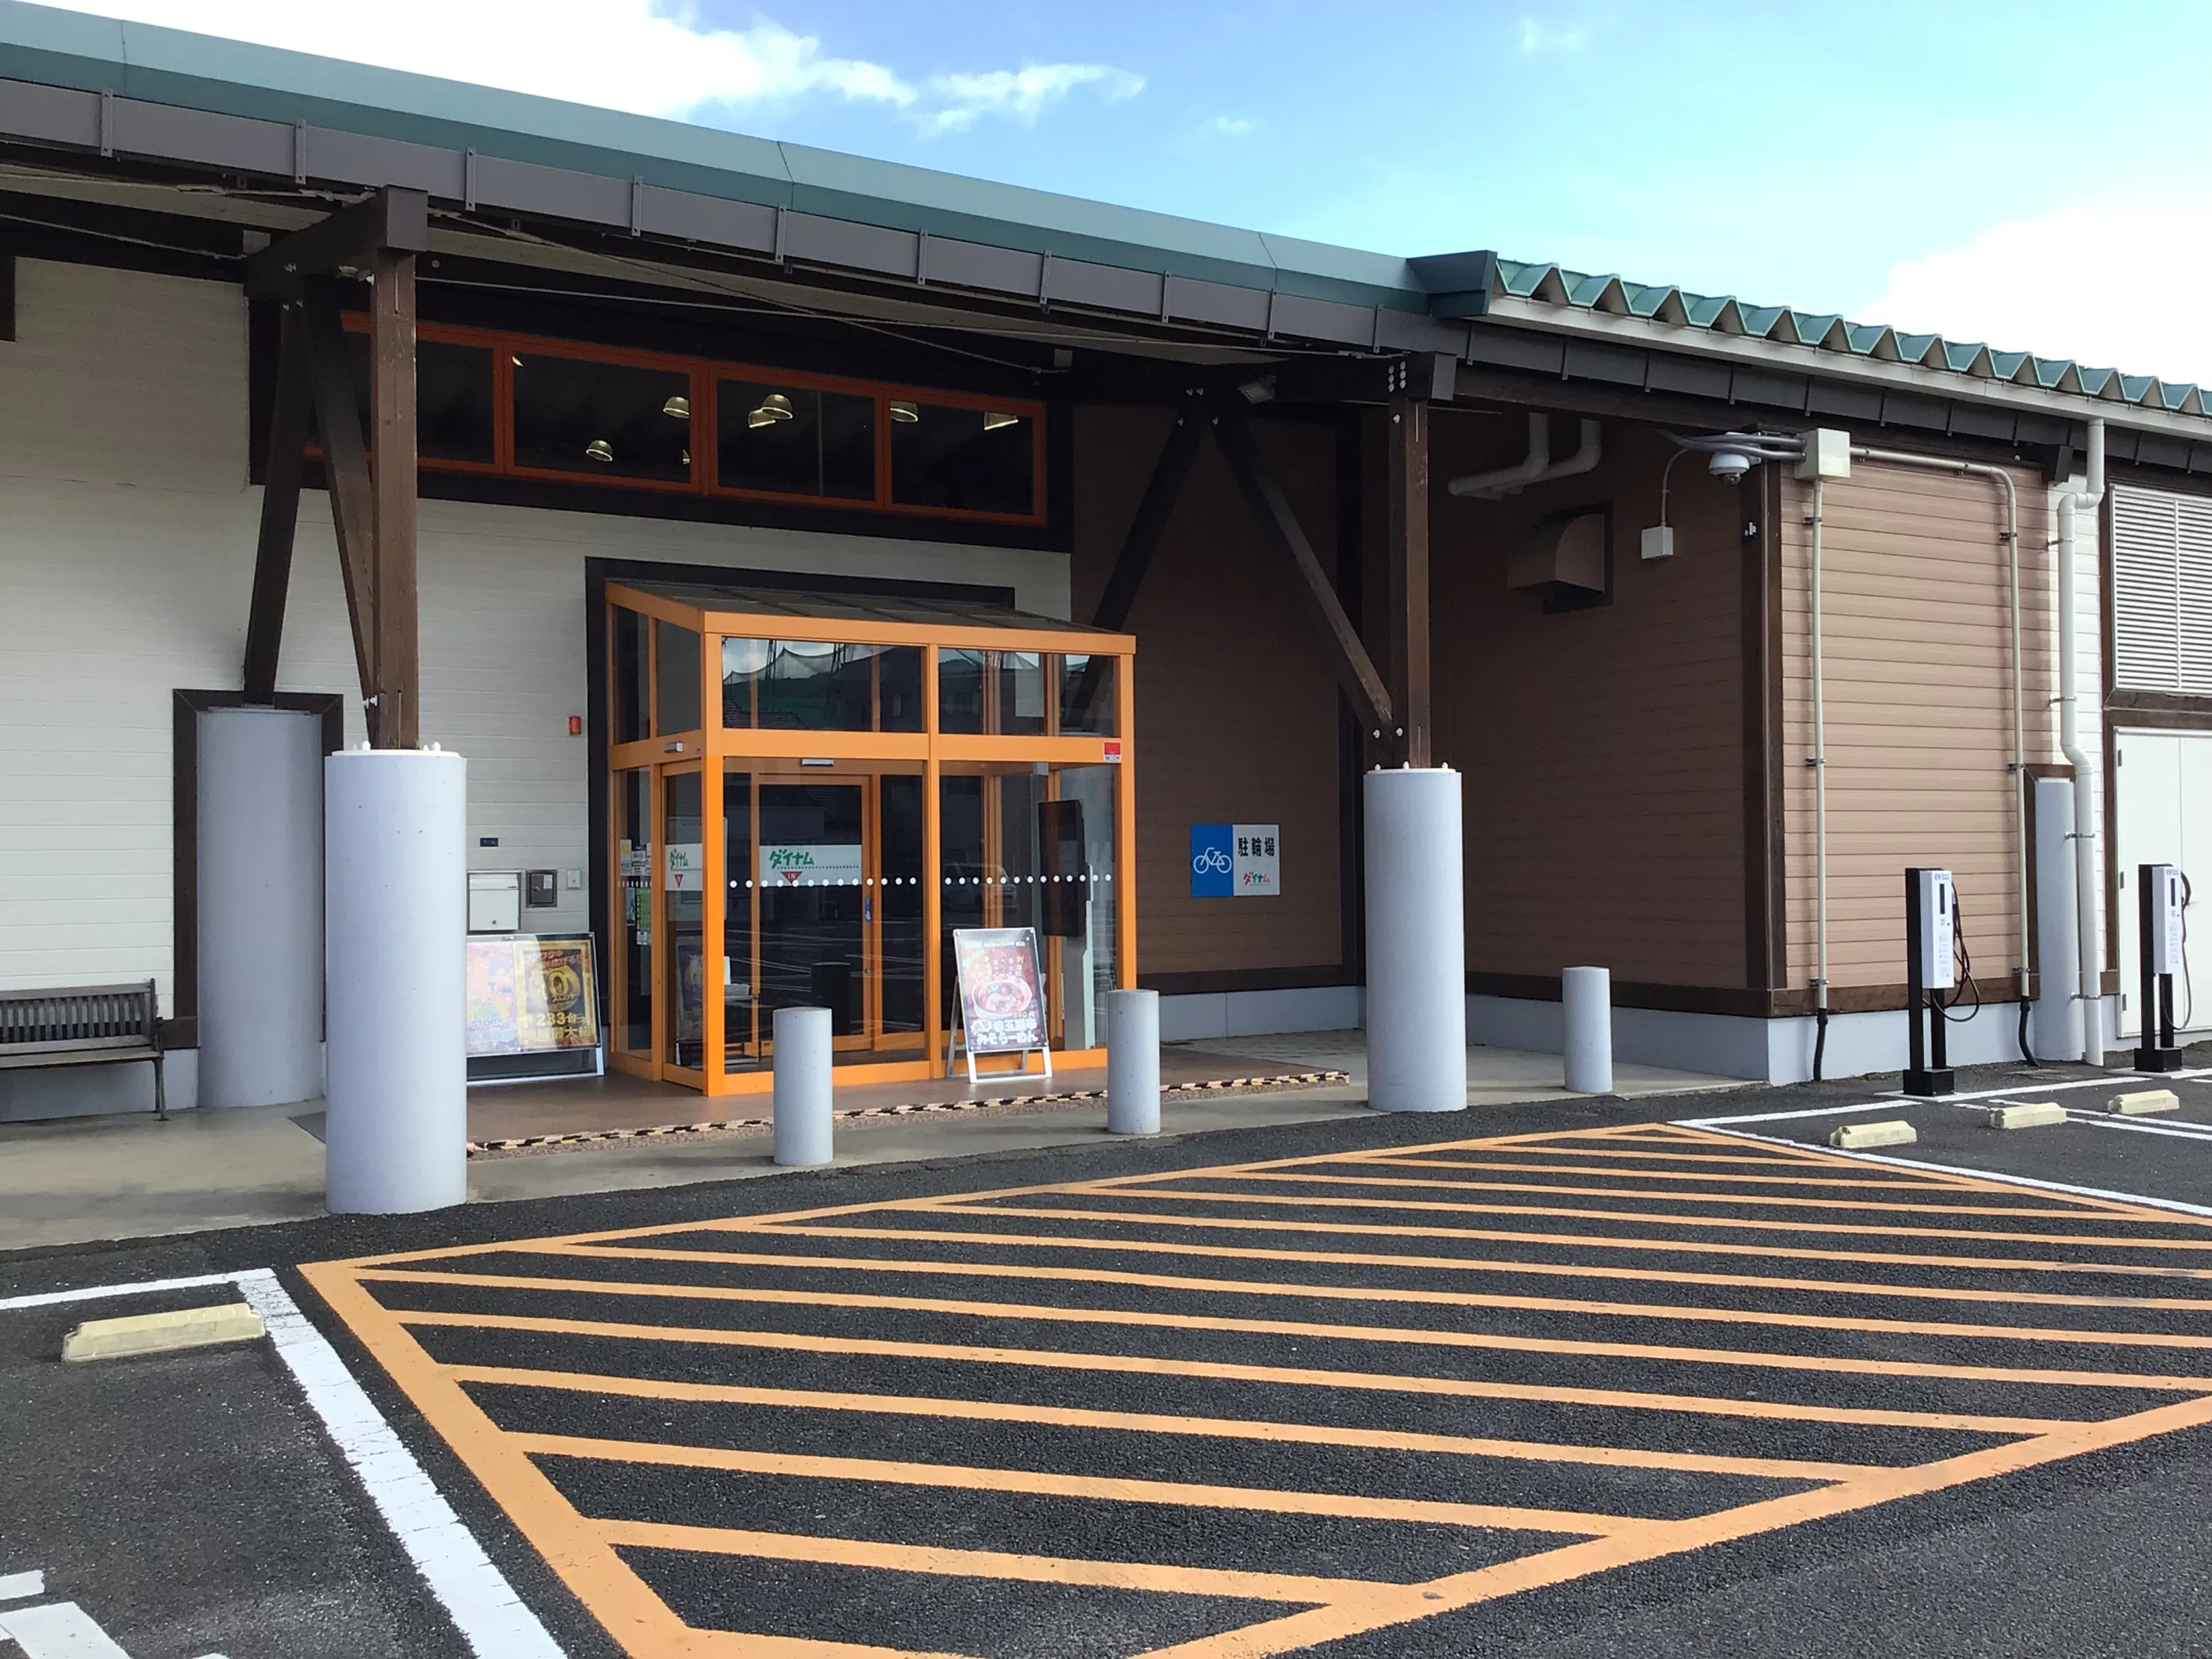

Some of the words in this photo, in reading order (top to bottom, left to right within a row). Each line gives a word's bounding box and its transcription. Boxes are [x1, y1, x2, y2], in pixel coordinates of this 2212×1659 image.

[1238, 837, 1275, 857] 駐輪場
[769, 848, 814, 869] ダイナム
[1243, 872, 1271, 886] ダイナム
